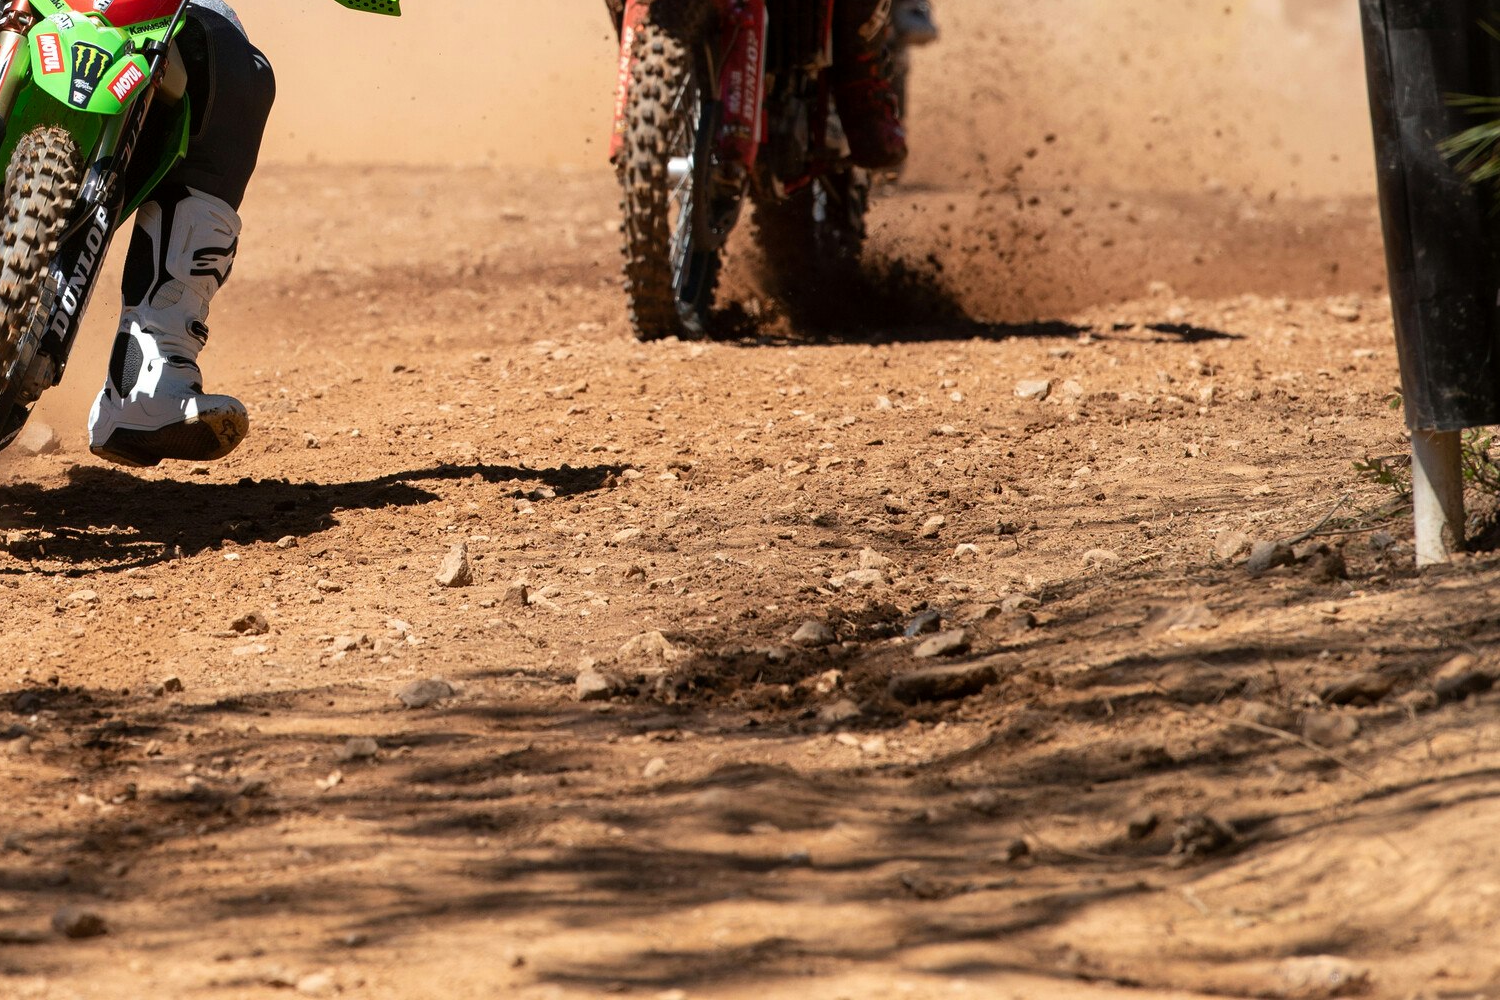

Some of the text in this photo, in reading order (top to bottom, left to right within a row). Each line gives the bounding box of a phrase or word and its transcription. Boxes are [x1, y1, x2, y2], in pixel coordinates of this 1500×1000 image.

[129, 16, 174, 36] Kawasaki
[39, 35, 62, 72] MOTUL
[112, 65, 144, 100] MOTUL
[49, 205, 111, 343] DUNLOP
